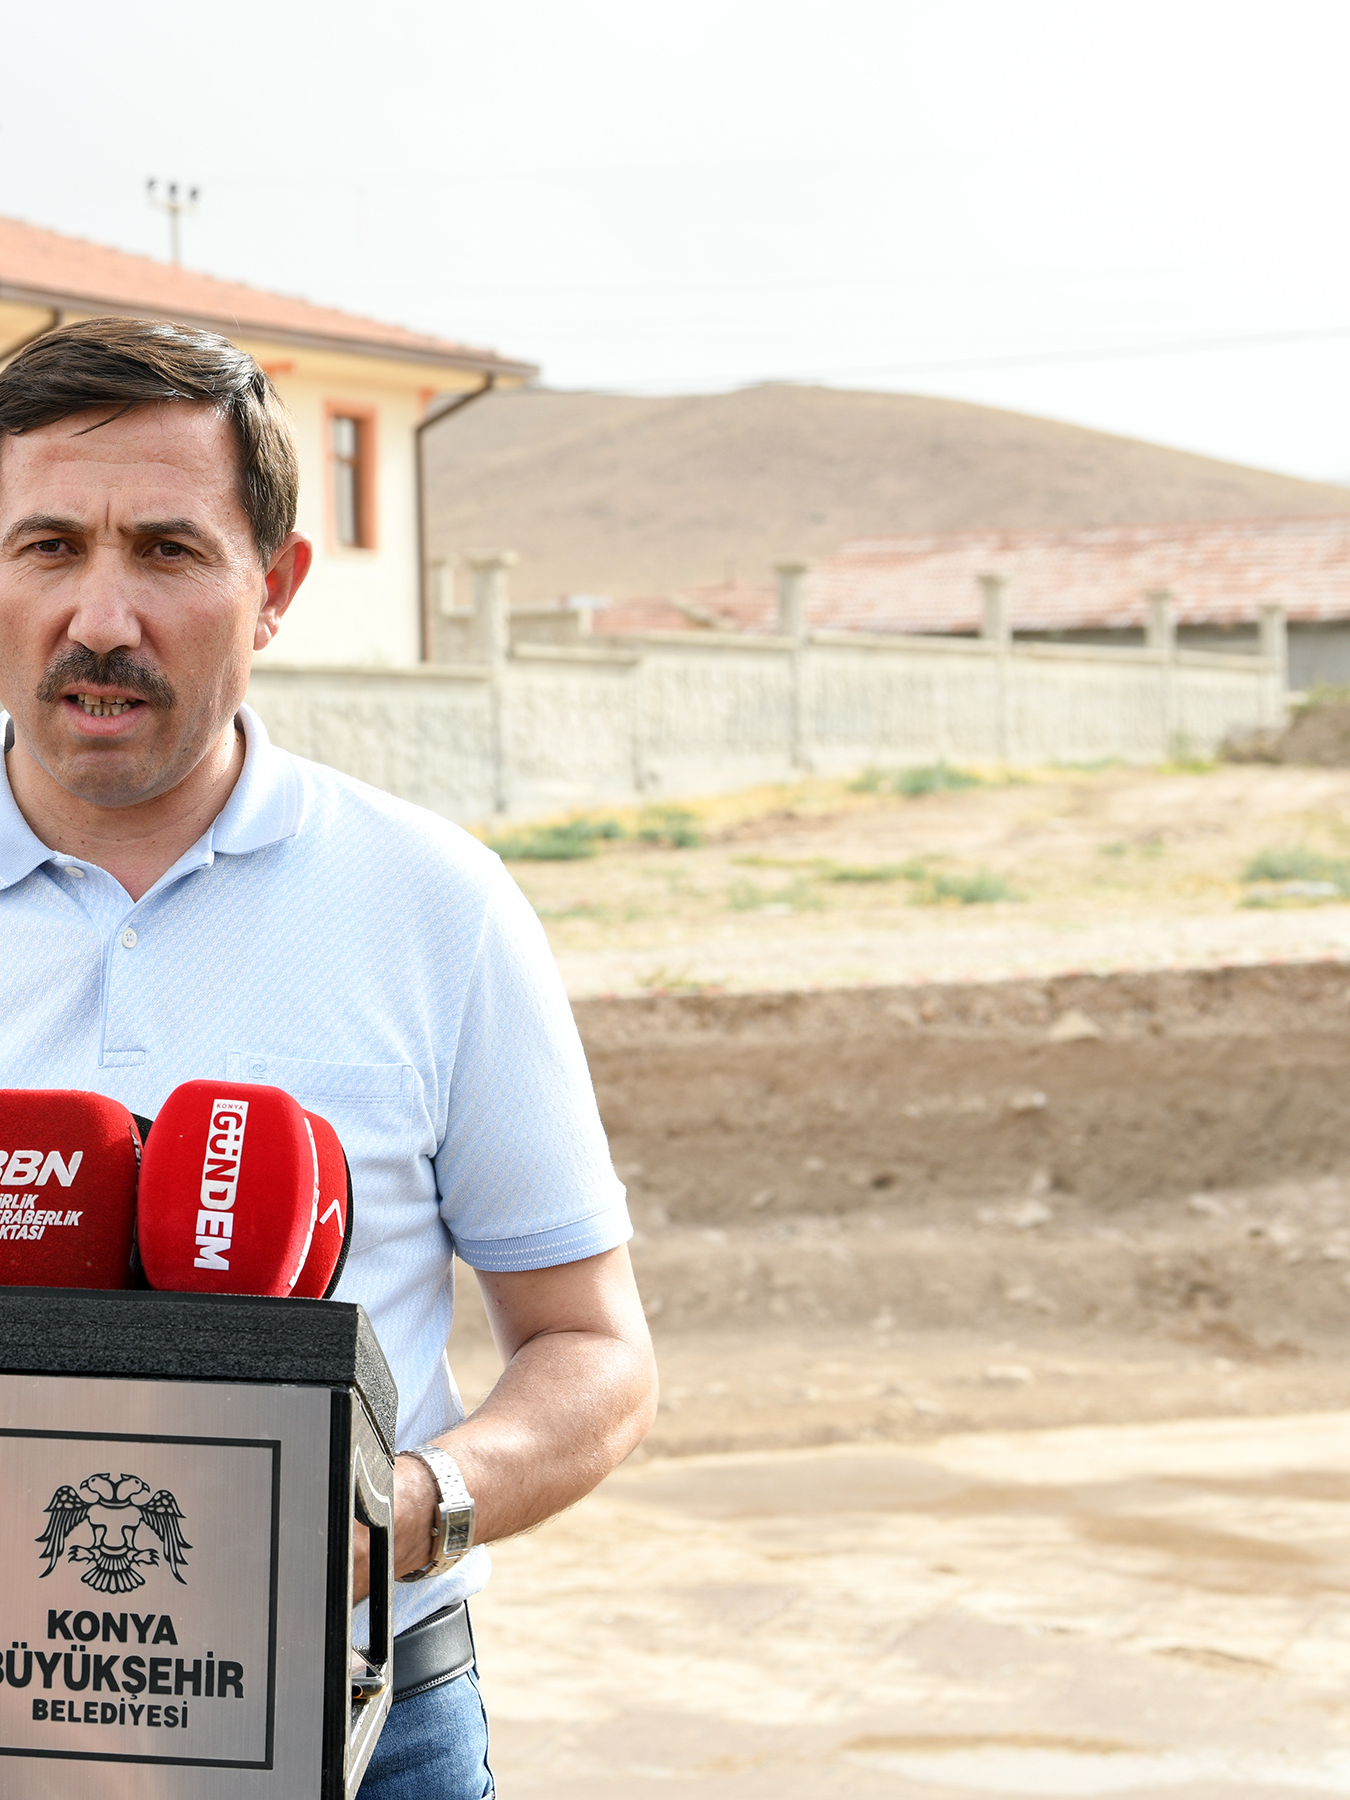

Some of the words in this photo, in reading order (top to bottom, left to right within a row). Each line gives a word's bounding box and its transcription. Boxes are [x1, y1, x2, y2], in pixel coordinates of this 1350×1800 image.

[216, 1103, 244, 1111] KONYA
[194, 1110, 243, 1271] GÜNDEM
[48, 1610, 178, 1645] KONYA
[33, 1698, 188, 1729] BELEDİYESİ
